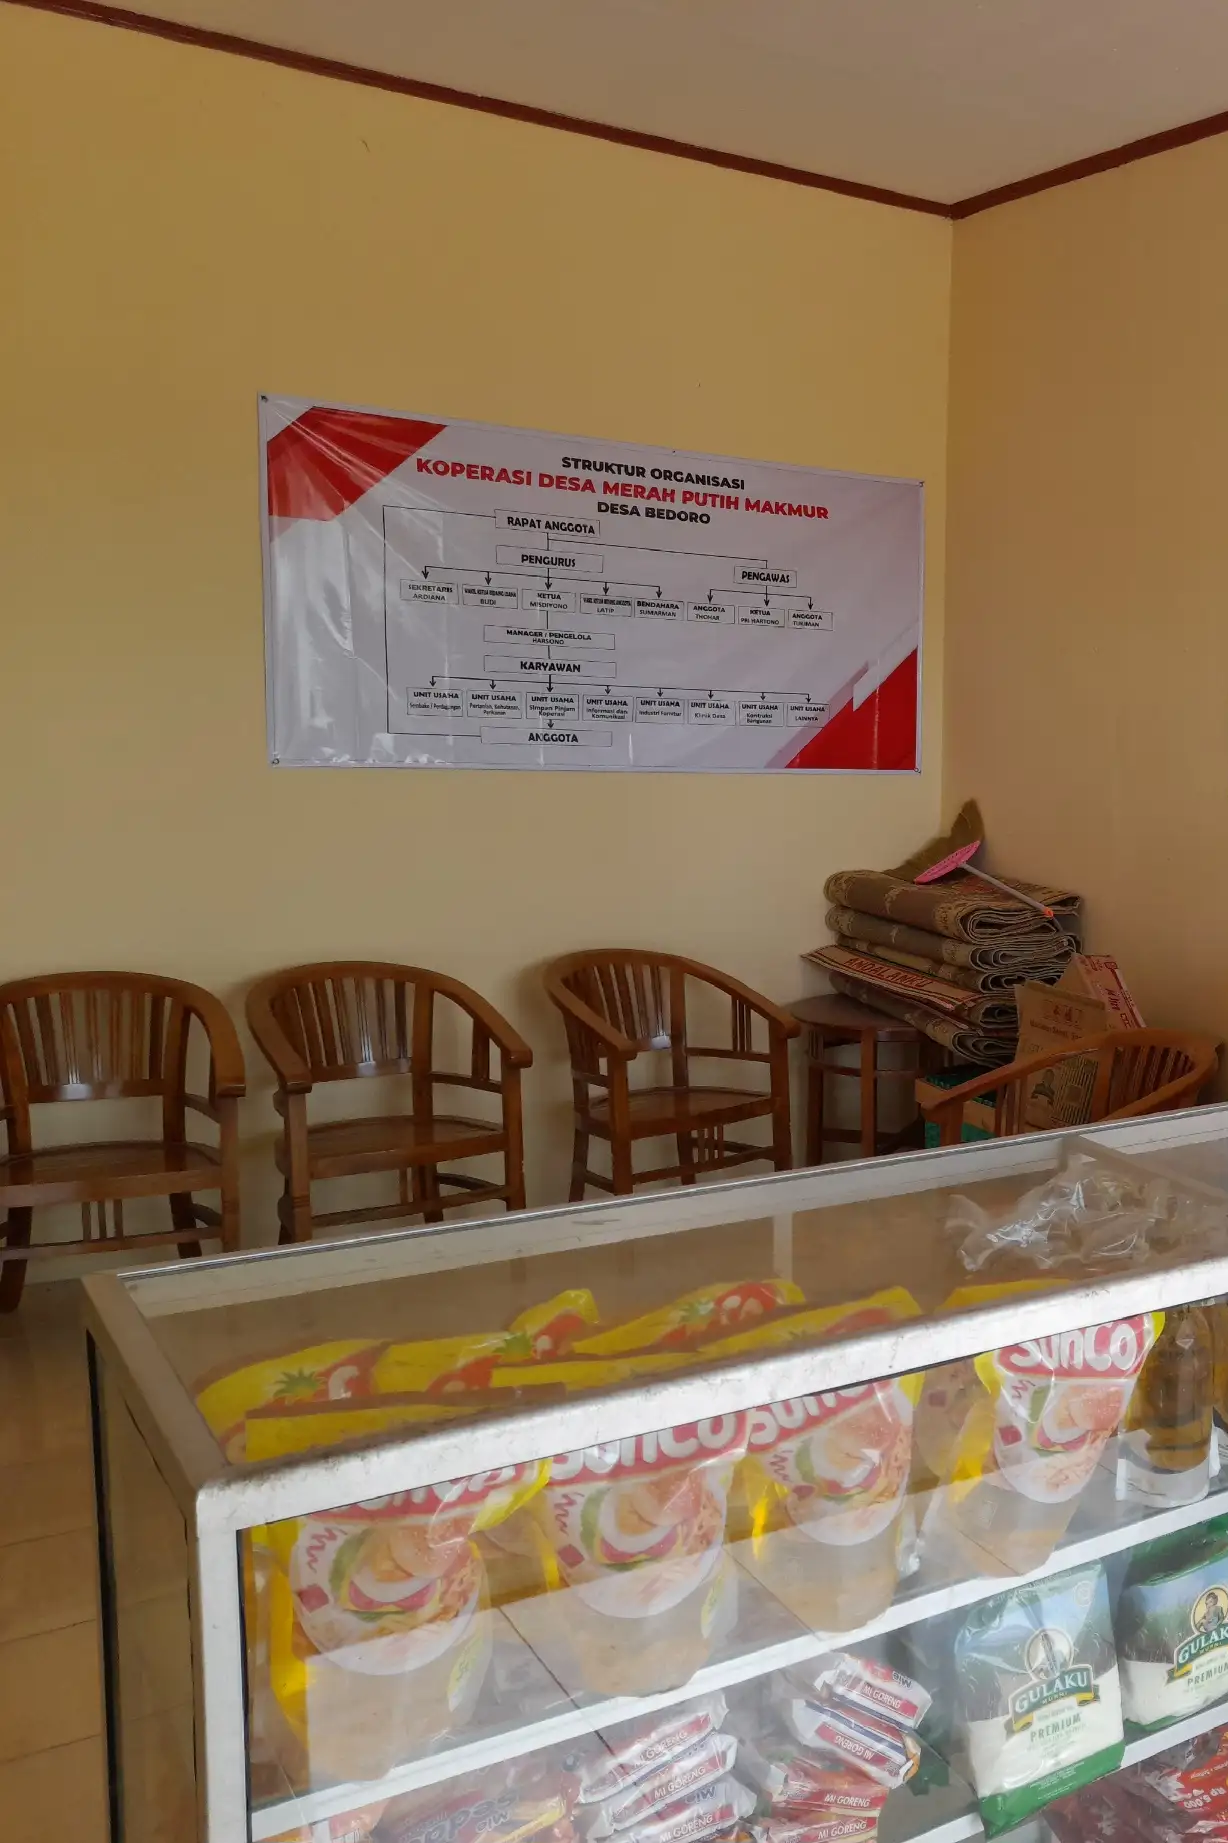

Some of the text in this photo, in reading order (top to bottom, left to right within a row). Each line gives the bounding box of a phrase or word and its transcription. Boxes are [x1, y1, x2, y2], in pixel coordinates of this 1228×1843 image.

[561, 456, 744, 490] STRUKTUR ORGANISASI
[417, 458, 829, 520] KOPERASI DESA MERAH PUTIH MAKMUR
[597, 501, 710, 524] DESA BEDORO
[507, 517, 595, 534] RAPAT ANGGOTA
[521, 554, 576, 568] PENGURUS
[742, 571, 789, 583] PENGAWAS
[408, 584, 453, 593] SEKRETARIS
[413, 593, 446, 601] ARDIANA
[537, 592, 562, 601] KETUA
[637, 601, 679, 610] BENDAHARA
[693, 605, 725, 613] ANGGOTA
[639, 609, 676, 617] SUMARMAN
[506, 629, 592, 641] MANAGER PENGELOLA
[520, 661, 581, 673] KARYAWAN
[528, 733, 578, 743] ANGGOTA
[1015, 1671, 1088, 1712] GULAKU
[1030, 1713, 1081, 1742] PREMIUM
[653, 1766, 706, 1799] MI GORENG
[824, 1793, 871, 1807] MI GORENG
[673, 1815, 713, 1838] GORENG
[817, 1821, 866, 1839] MI GORENG
